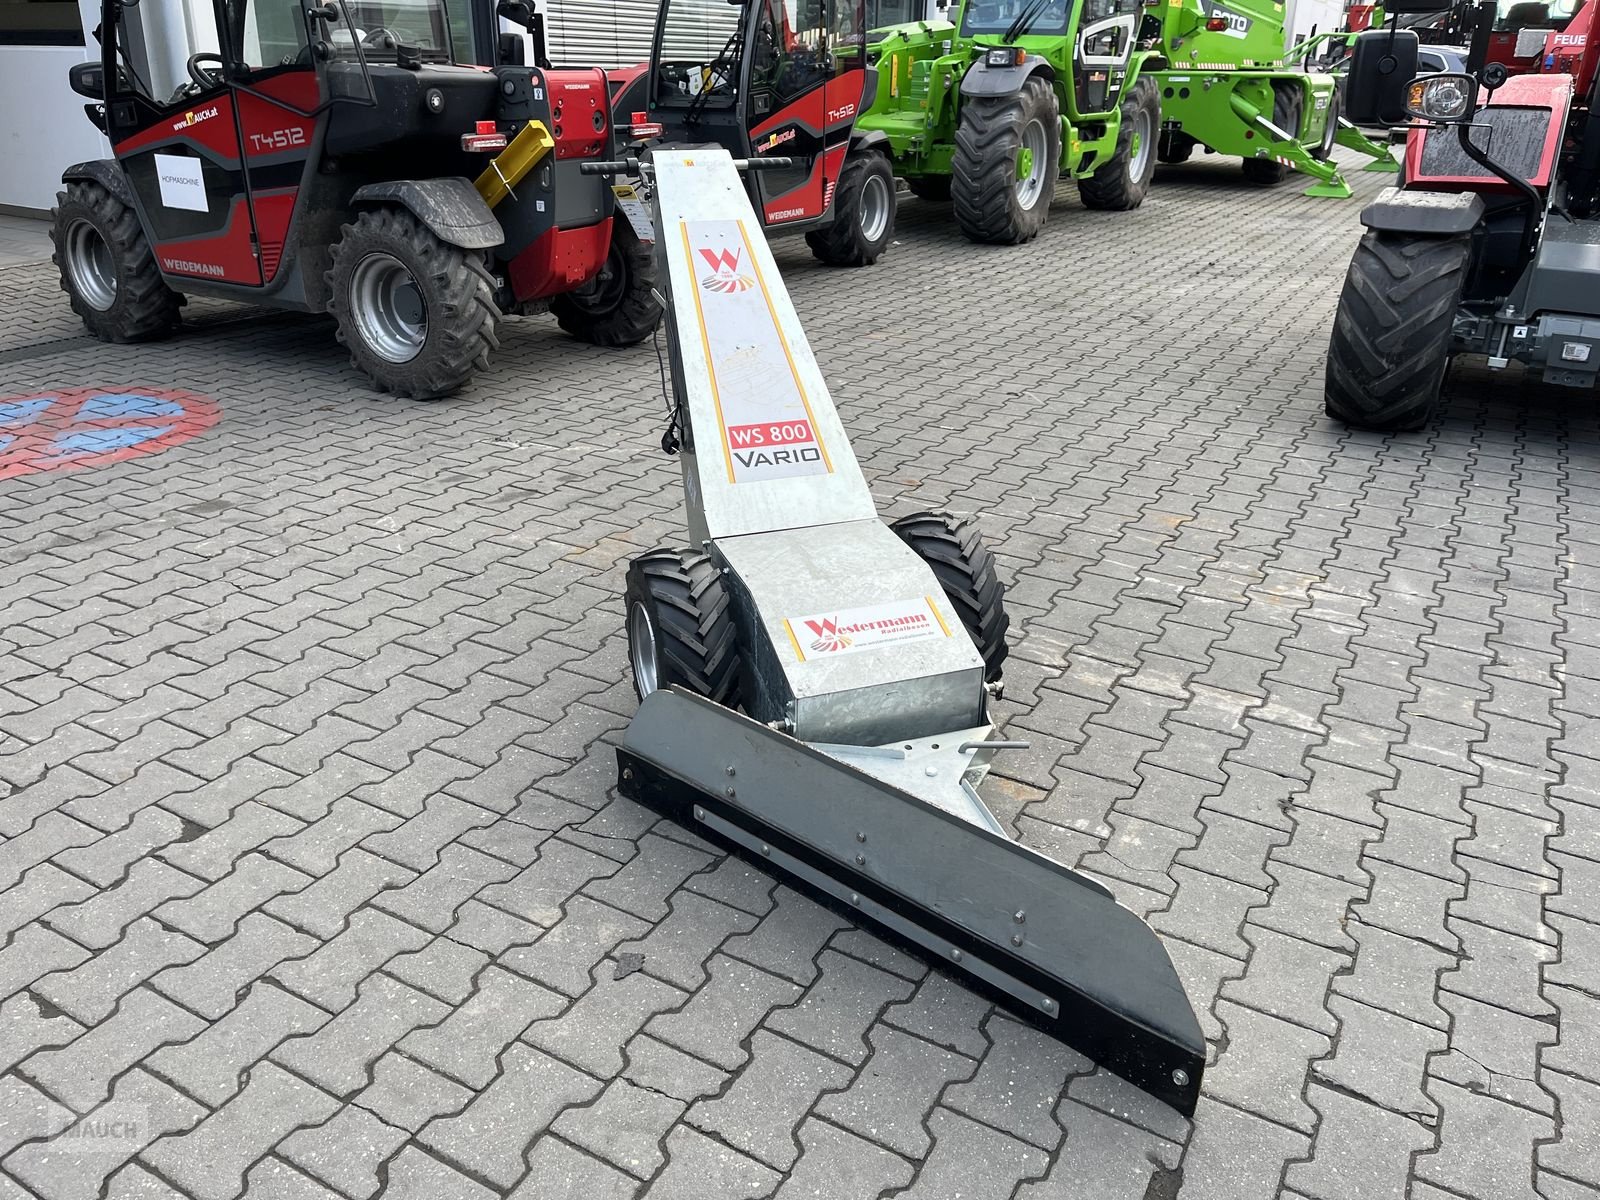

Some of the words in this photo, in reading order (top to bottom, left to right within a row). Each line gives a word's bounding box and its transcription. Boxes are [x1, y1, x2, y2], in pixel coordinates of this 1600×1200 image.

[828, 103, 855, 122] T4512
[250, 127, 306, 151] T4512
[161, 175, 199, 187] HOFMASCHINE
[768, 208, 804, 221] WEIDEMANN
[163, 258, 225, 277] WEIDEMANN
[731, 428, 765, 446] WS
[769, 424, 807, 442] 800
[733, 447, 820, 468] VARIO
[804, 615, 927, 638] Westermann
